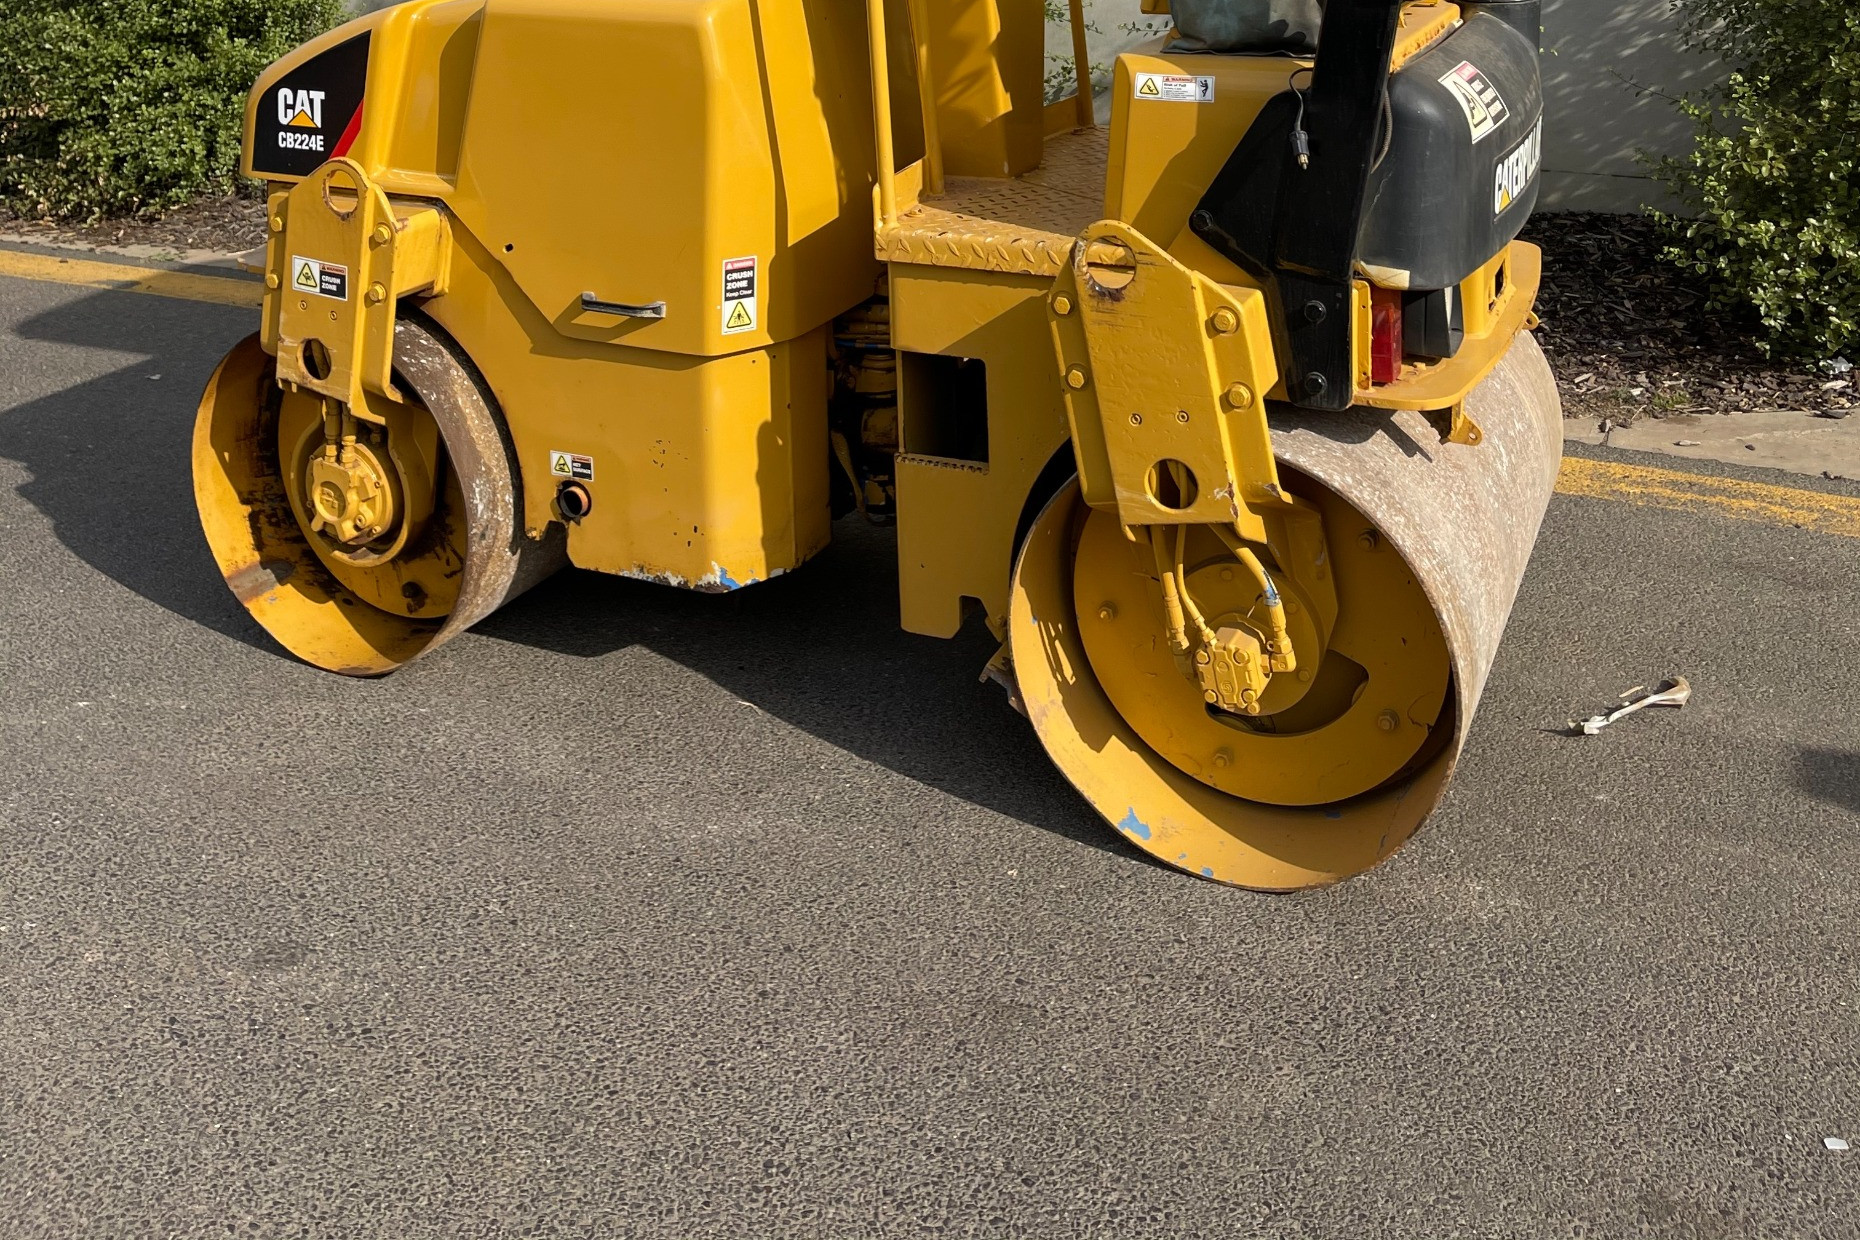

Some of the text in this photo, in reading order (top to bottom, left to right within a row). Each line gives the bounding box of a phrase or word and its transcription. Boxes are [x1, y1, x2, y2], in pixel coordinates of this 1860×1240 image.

[277, 87, 326, 129] CAT
[278, 131, 325, 152] CB224E
[321, 275, 341, 285] CRUSH
[726, 270, 753, 281] CRUSH
[321, 282, 337, 291] ZONE
[726, 280, 748, 290] ZONE
